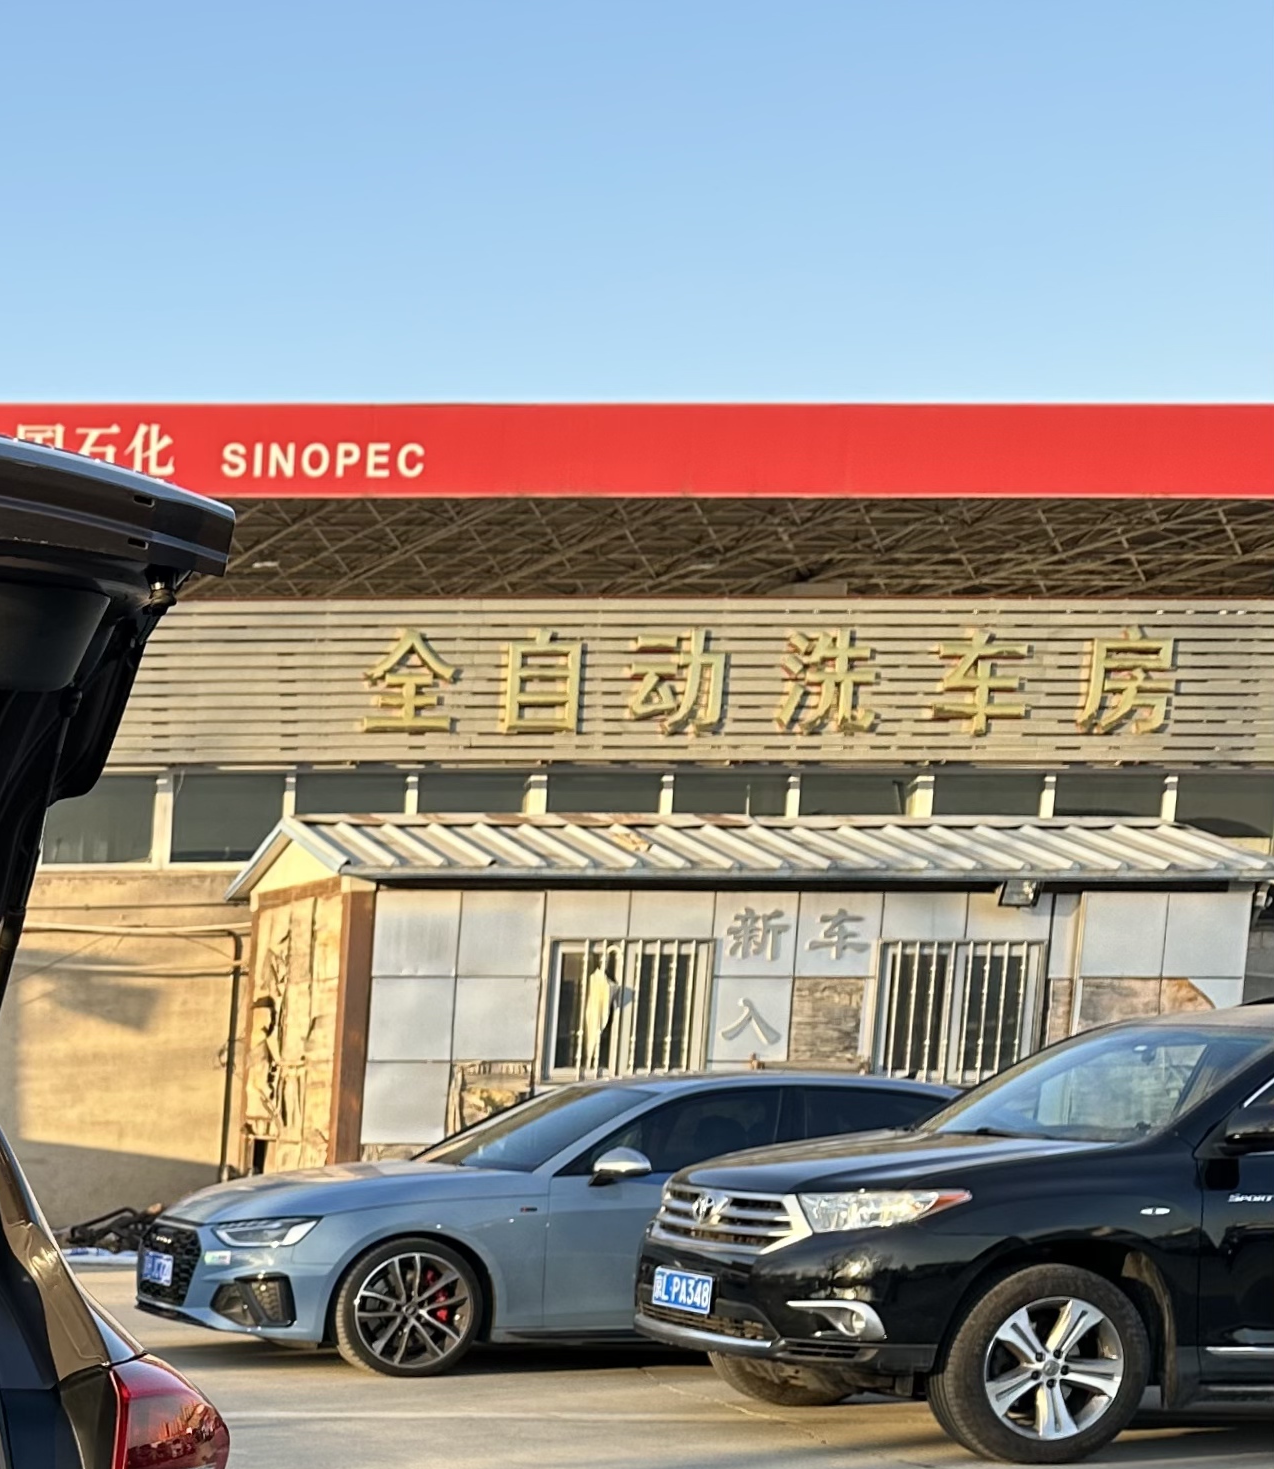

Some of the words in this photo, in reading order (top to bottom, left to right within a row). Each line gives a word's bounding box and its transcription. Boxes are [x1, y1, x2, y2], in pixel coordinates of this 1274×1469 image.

[221, 442, 425, 478] SINOPEC
[362, 625, 1175, 736] 全自动洗车房
[726, 906, 872, 961] 新车
[720, 997, 782, 1046] 入
